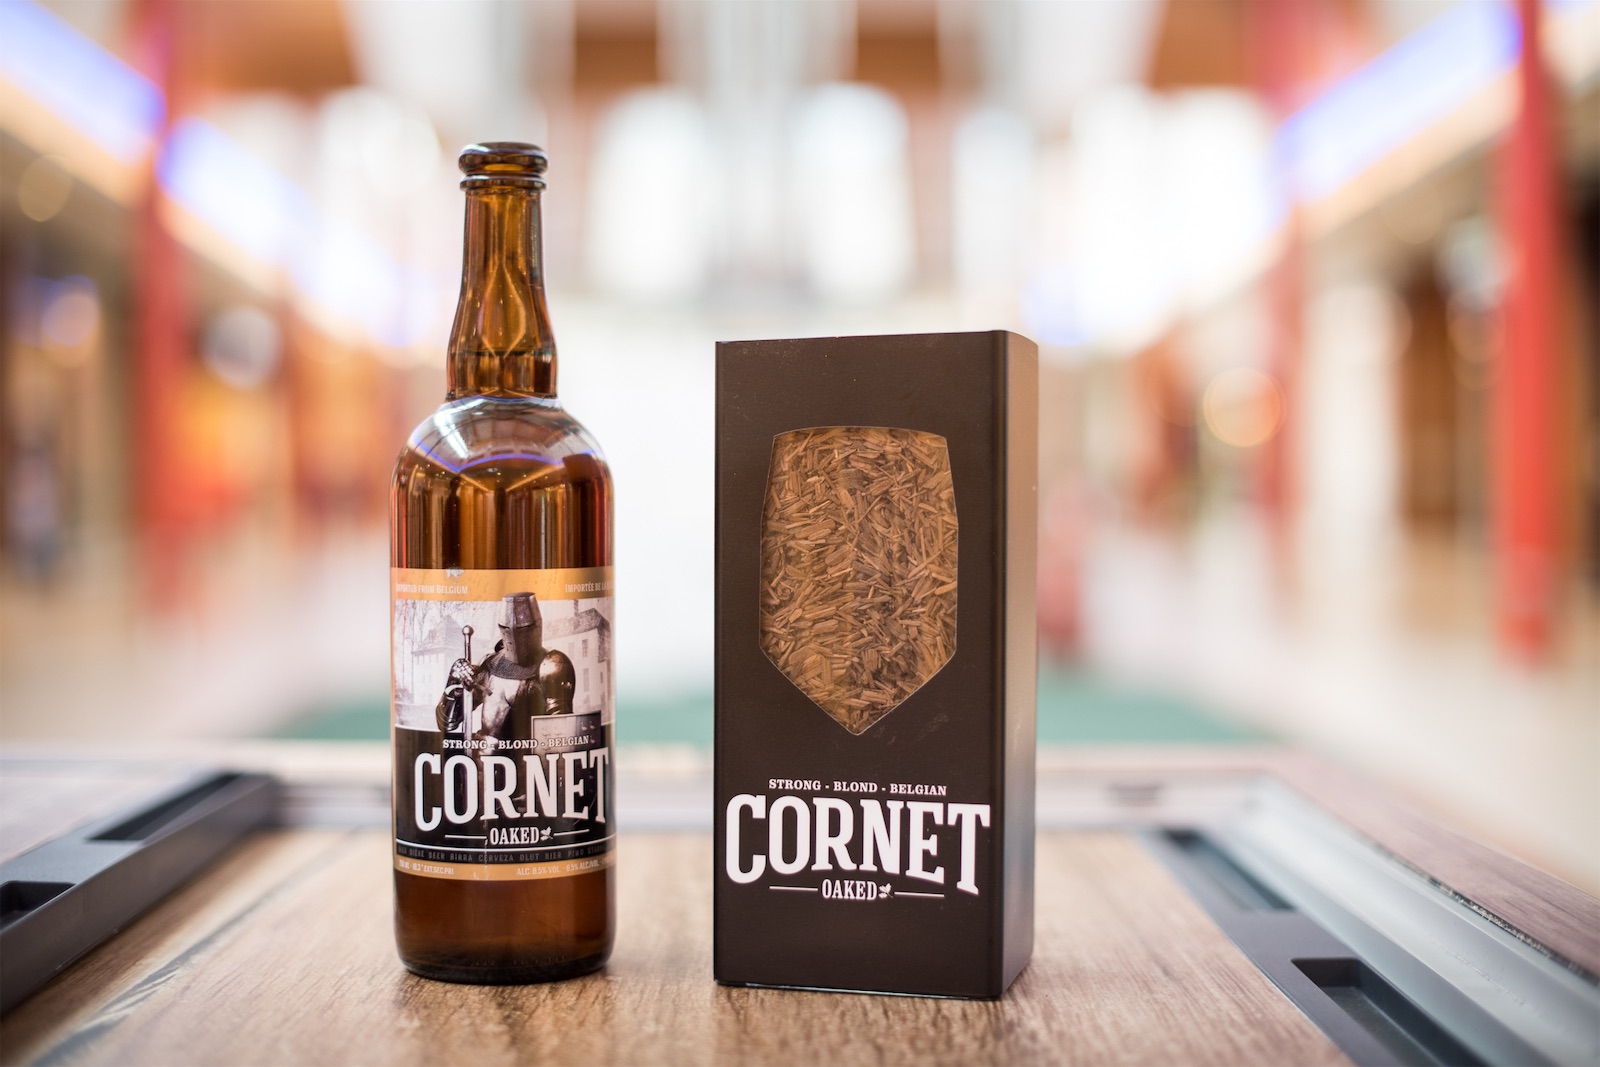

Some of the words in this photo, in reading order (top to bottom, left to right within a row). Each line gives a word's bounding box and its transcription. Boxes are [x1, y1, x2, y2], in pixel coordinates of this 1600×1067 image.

[418, 584, 435, 594] FROM
[436, 584, 468, 595] BELGIUM
[565, 581, 595, 593] IMPORTÉE
[442, 739, 487, 749] STRONG
[498, 739, 538, 749] BLOND
[548, 735, 590, 748] BELGIAN
[414, 747, 609, 832] CORNET
[768, 778, 822, 791] STRONG
[833, 781, 878, 793] BLOND
[889, 784, 947, 796] BELGIAN
[490, 826, 540, 845] OAKED
[726, 793, 991, 896] CORNET
[822, 878, 878, 901] OAKED
